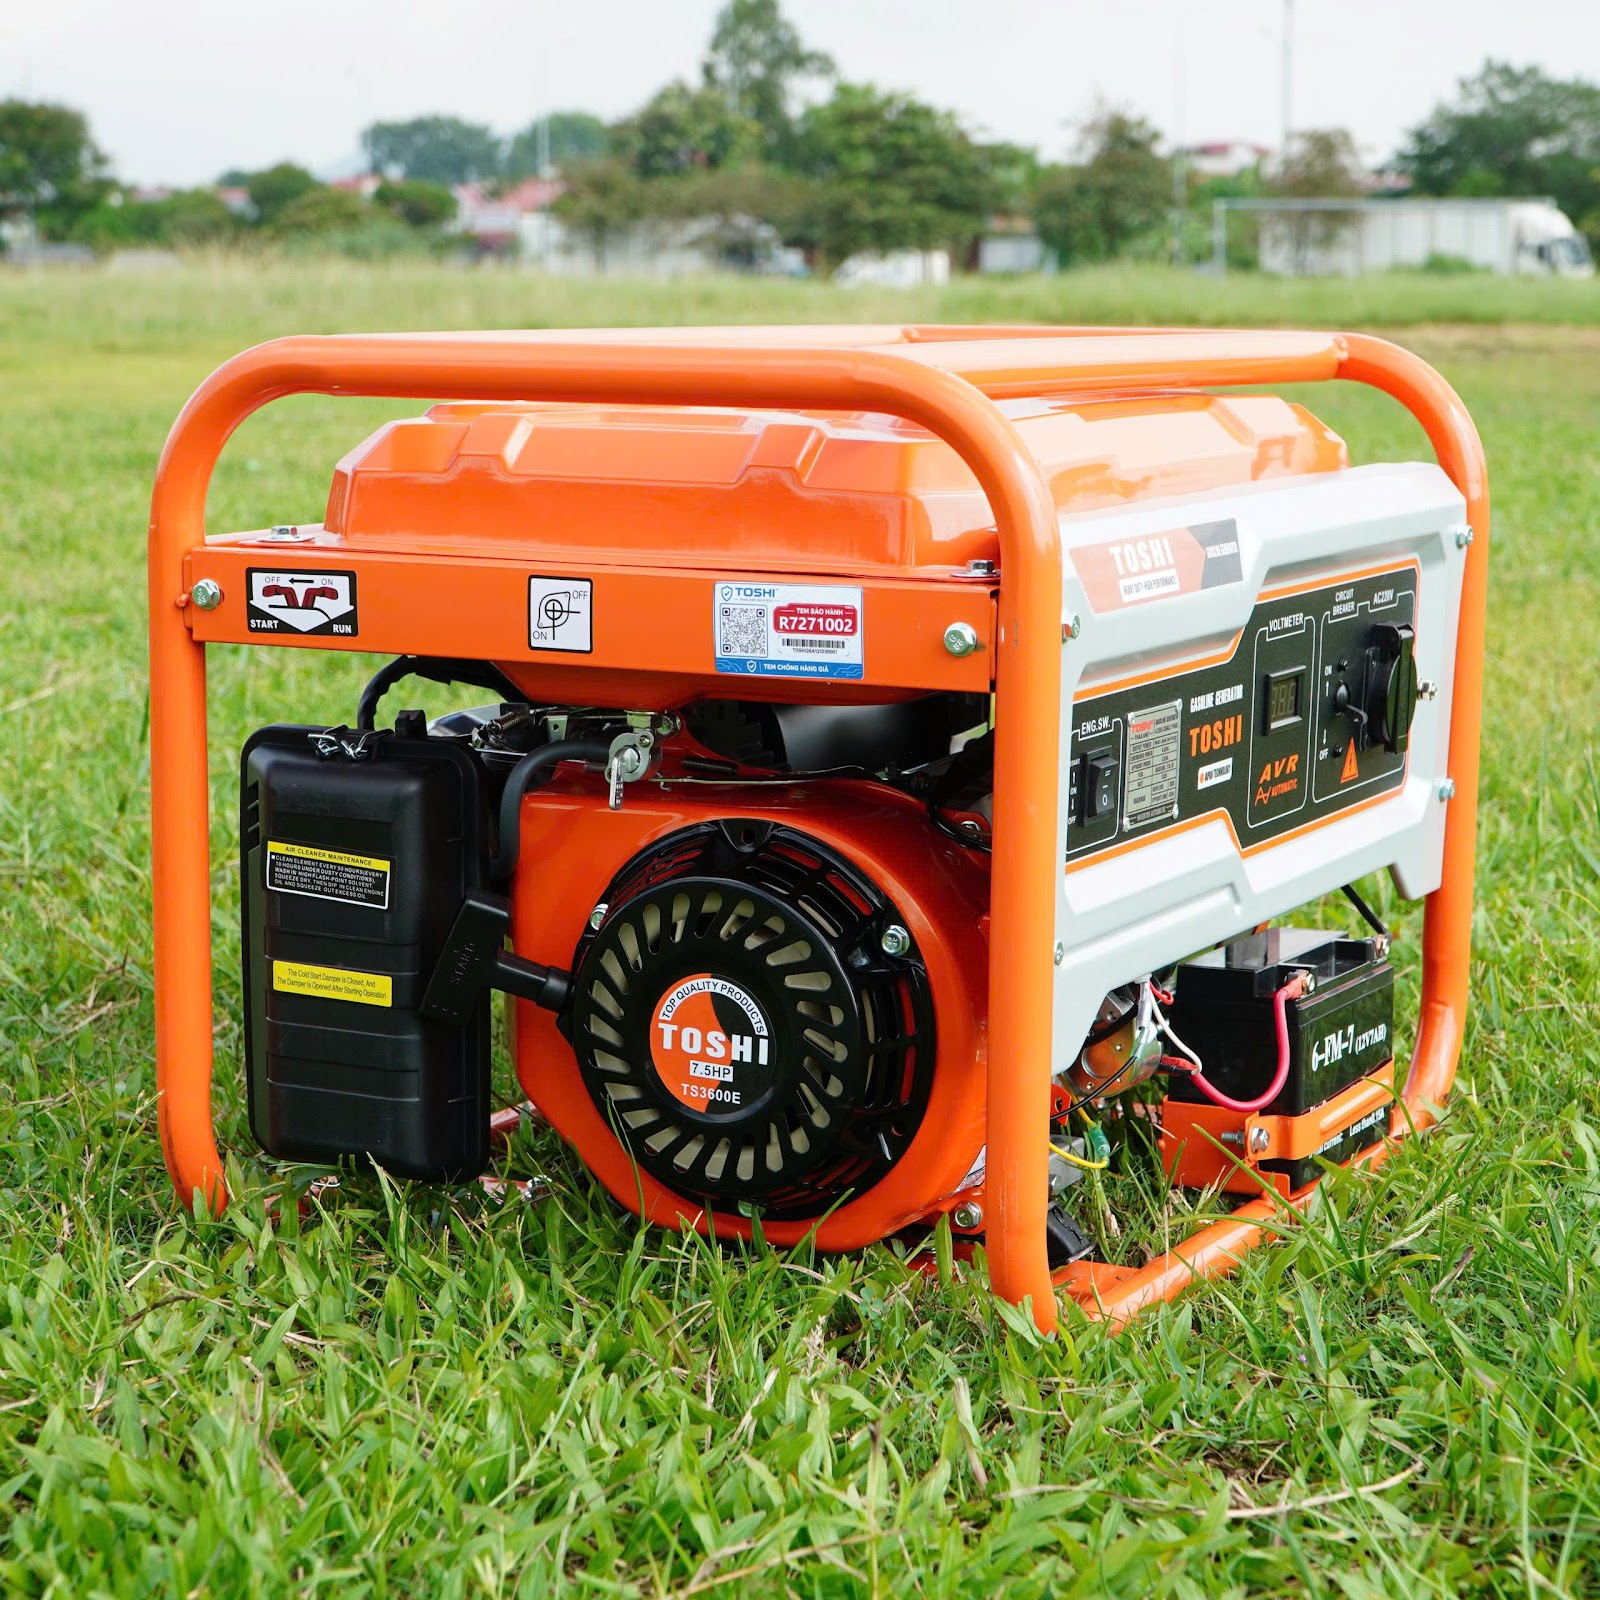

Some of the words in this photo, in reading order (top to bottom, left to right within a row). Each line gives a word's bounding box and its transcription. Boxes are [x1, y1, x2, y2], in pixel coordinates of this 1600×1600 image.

[1110, 538, 1174, 576] TOSHI
[264, 576, 281, 584] OFF
[321, 578, 334, 586] ON
[572, 590, 588, 600] OFF
[735, 588, 775, 598] TOSHI
[1336, 589, 1354, 602] CIRCUIT
[1373, 589, 1394, 604] AC220V
[1333, 602, 1355, 616] BREAKER
[250, 619, 279, 630] START
[332, 622, 352, 634] RUN
[779, 616, 853, 632] R7271002
[1270, 613, 1304, 631] VOLTMETER
[532, 631, 548, 640] ON
[1325, 665, 1332, 676] ON
[1190, 692, 1214, 712] GASOLINE
[1081, 716, 1110, 735] ENG.SW.
[1190, 714, 1242, 757] TOSHI
[1320, 749, 1328, 760] OFF
[1259, 754, 1298, 784] AVR
[1070, 787, 1077, 795] ON
[1271, 779, 1297, 797] AUTOMATIC
[294, 858, 318, 866] ELEMENT
[319, 862, 337, 870] EVERY
[298, 848, 326, 858] CLEANER
[328, 852, 372, 866] MAINTENANCE
[282, 862, 301, 870] HOURS
[302, 865, 320, 873] UNDER
[274, 873, 298, 882] SQUEEZE
[346, 884, 363, 892] CLEAN
[364, 888, 384, 897] ENGINE
[296, 883, 321, 892] SQUEEZE
[335, 890, 356, 898] EXCESS
[288, 968, 297, 976] The
[298, 970, 309, 978] Cold
[310, 972, 321, 980] Start
[322, 974, 340, 983] Damper
[366, 979, 375, 987] And
[287, 979, 306, 989] Damper
[312, 982, 331, 992] Opened
[332, 985, 343, 993] After
[344, 986, 362, 997] Starting
[363, 988, 386, 999] Operation
[662, 999, 676, 1019] TOP
[676, 981, 719, 1000] QUALITY
[720, 984, 764, 1034] PRODUCTS
[658, 1022, 768, 1066] TOSHI
[1312, 1024, 1354, 1072] 6-FM-7
[1355, 1023, 1387, 1055] (12V7AH)
[692, 1063, 730, 1078] 7.5HP
[681, 1083, 740, 1104] TS3600E
